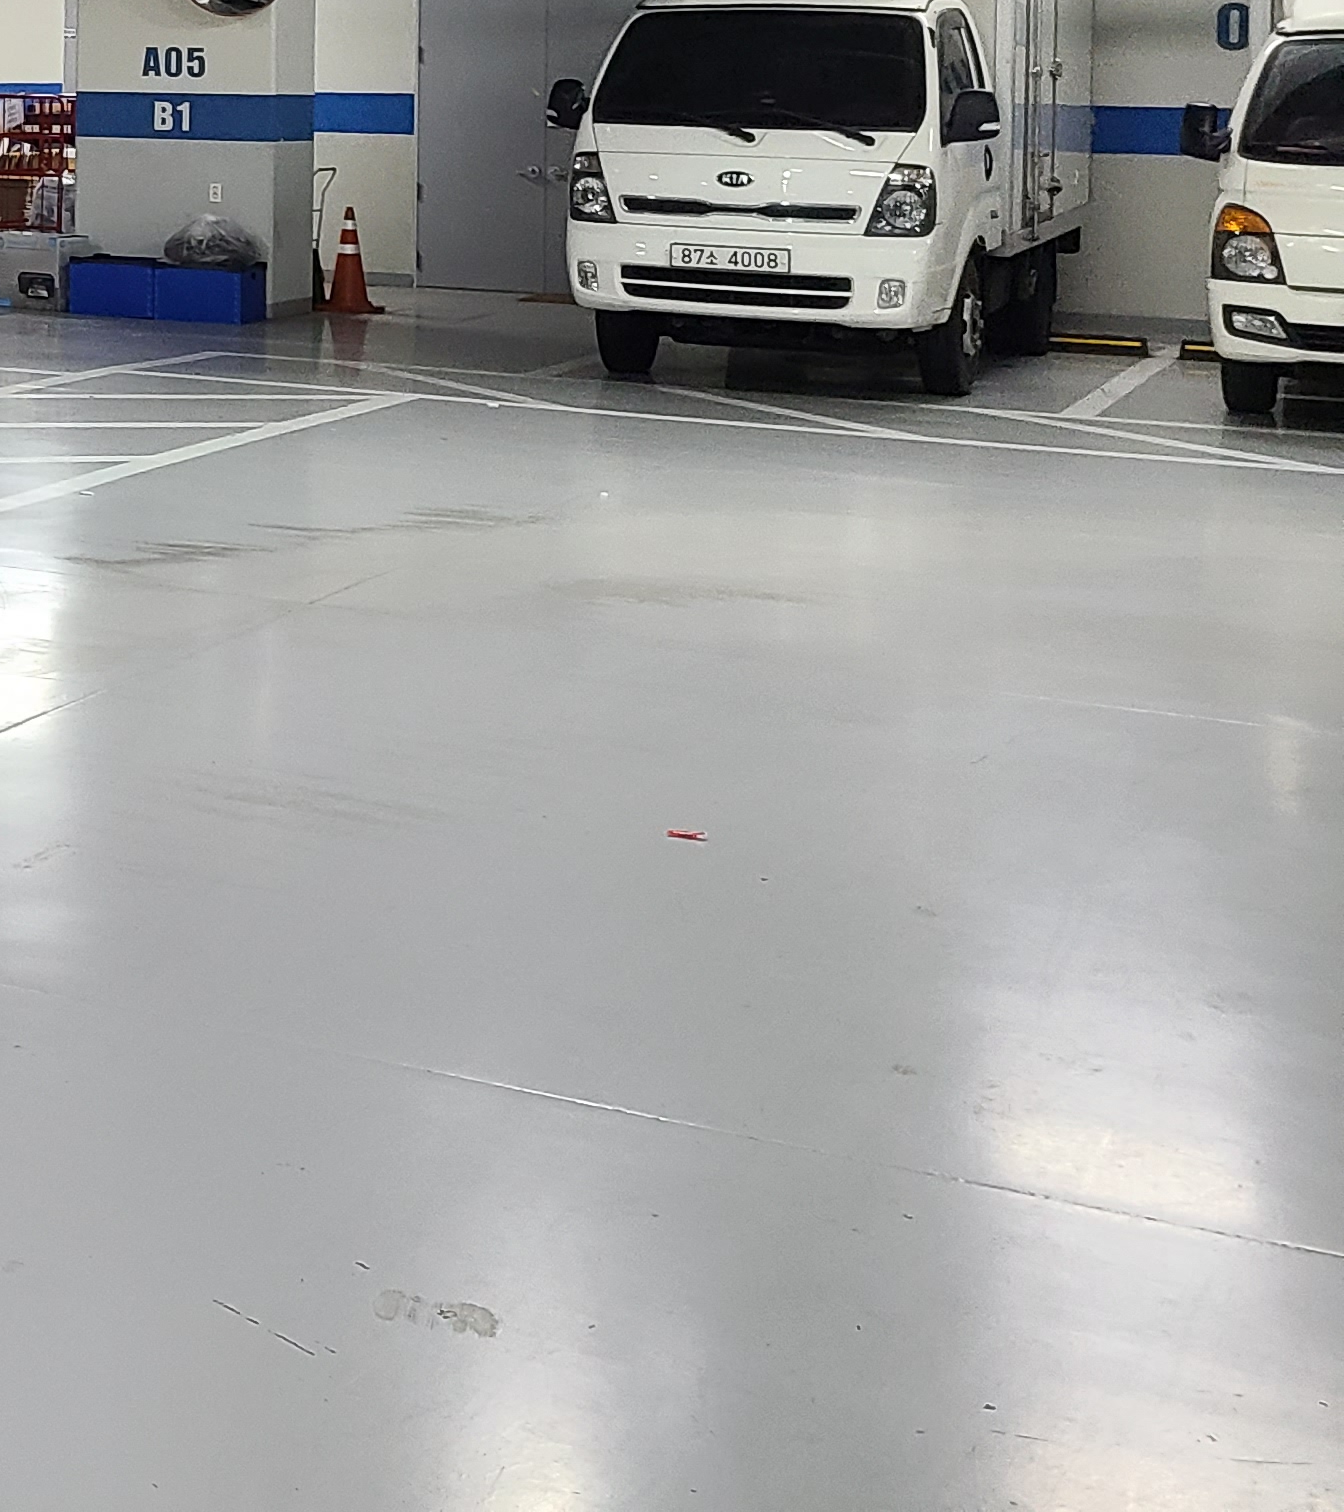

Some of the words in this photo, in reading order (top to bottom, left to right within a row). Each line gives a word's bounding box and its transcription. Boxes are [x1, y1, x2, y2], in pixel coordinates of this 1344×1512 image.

[142, 46, 206, 78] A05
[153, 100, 190, 131] B1
[722, 173, 749, 185] KIA
[681, 248, 718, 266] 87소
[728, 251, 778, 269] 4008
